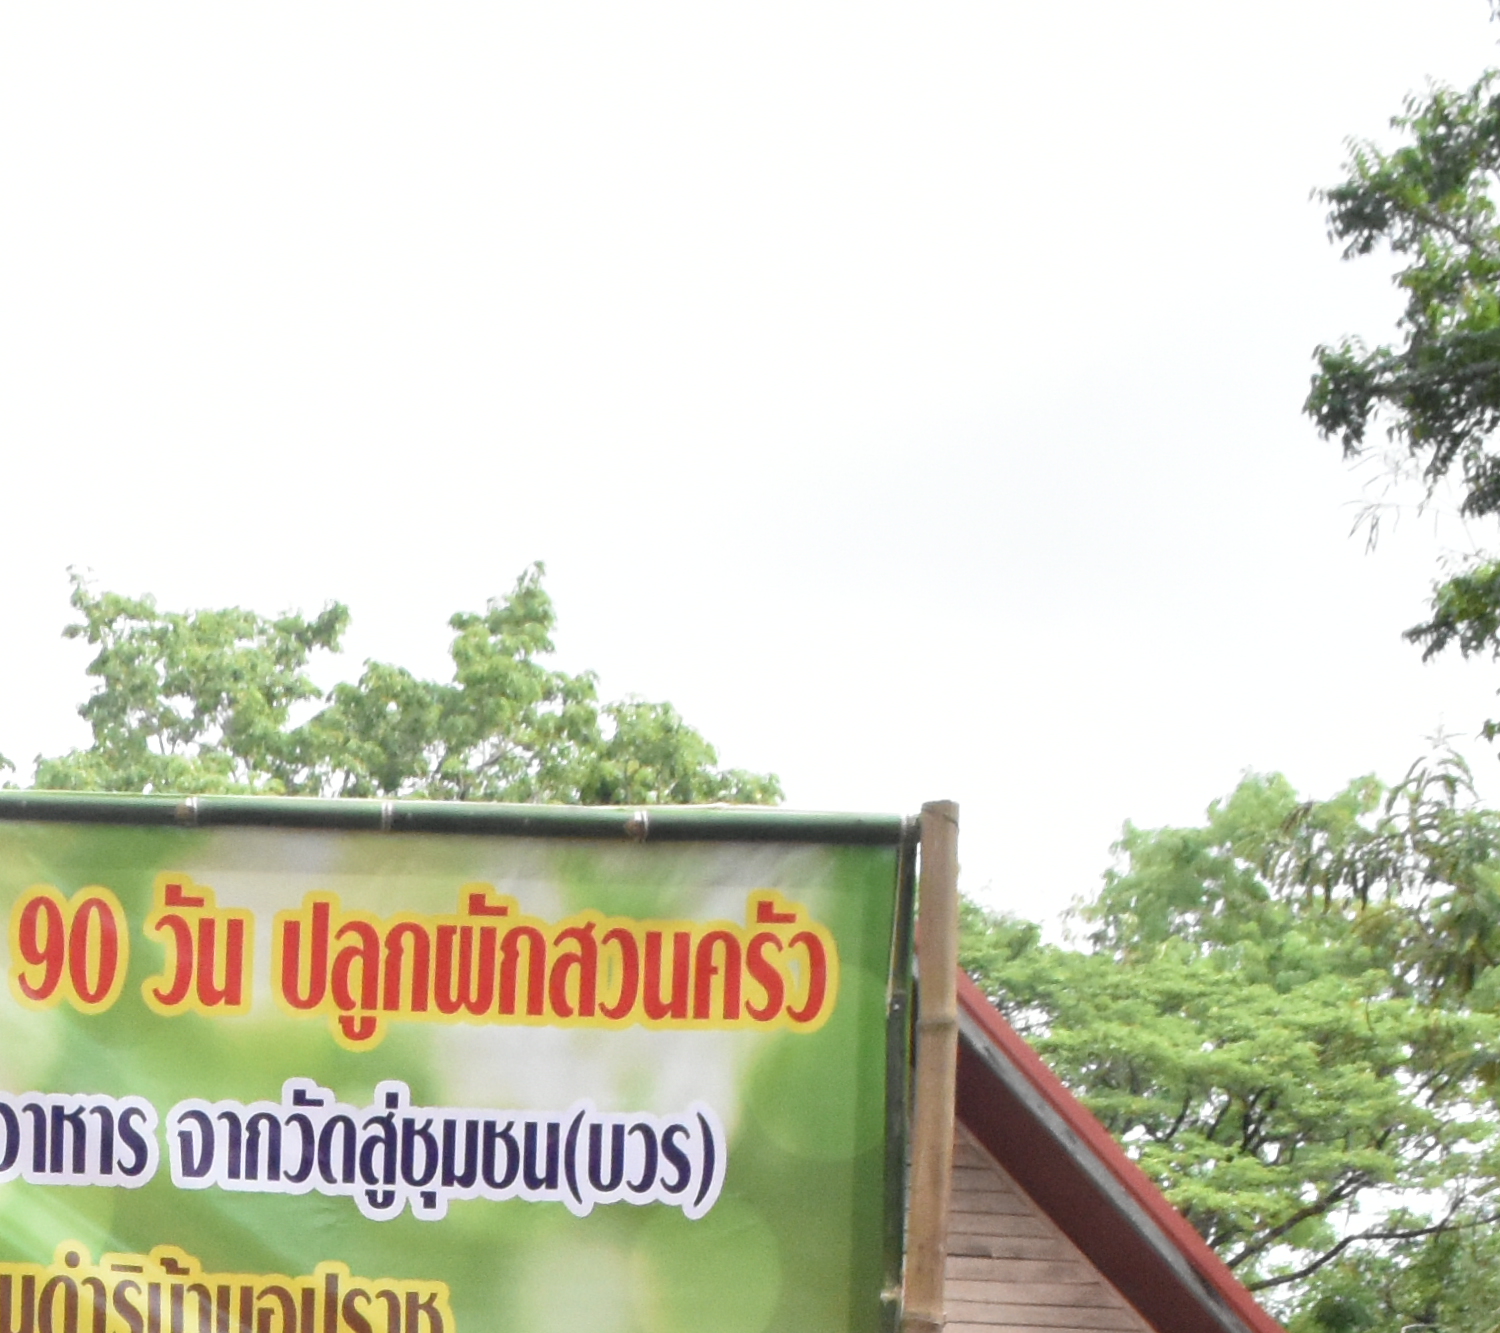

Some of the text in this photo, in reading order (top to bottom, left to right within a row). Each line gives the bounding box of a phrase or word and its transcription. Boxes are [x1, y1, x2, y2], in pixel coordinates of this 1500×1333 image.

[17, 895, 119, 1005] 90
[151, 884, 244, 1008] วัน
[281, 893, 828, 1041] ปลูกผักสวนครัว
[176, 1089, 716, 1210] จากวัดสู่ชุมชน(บวร)
